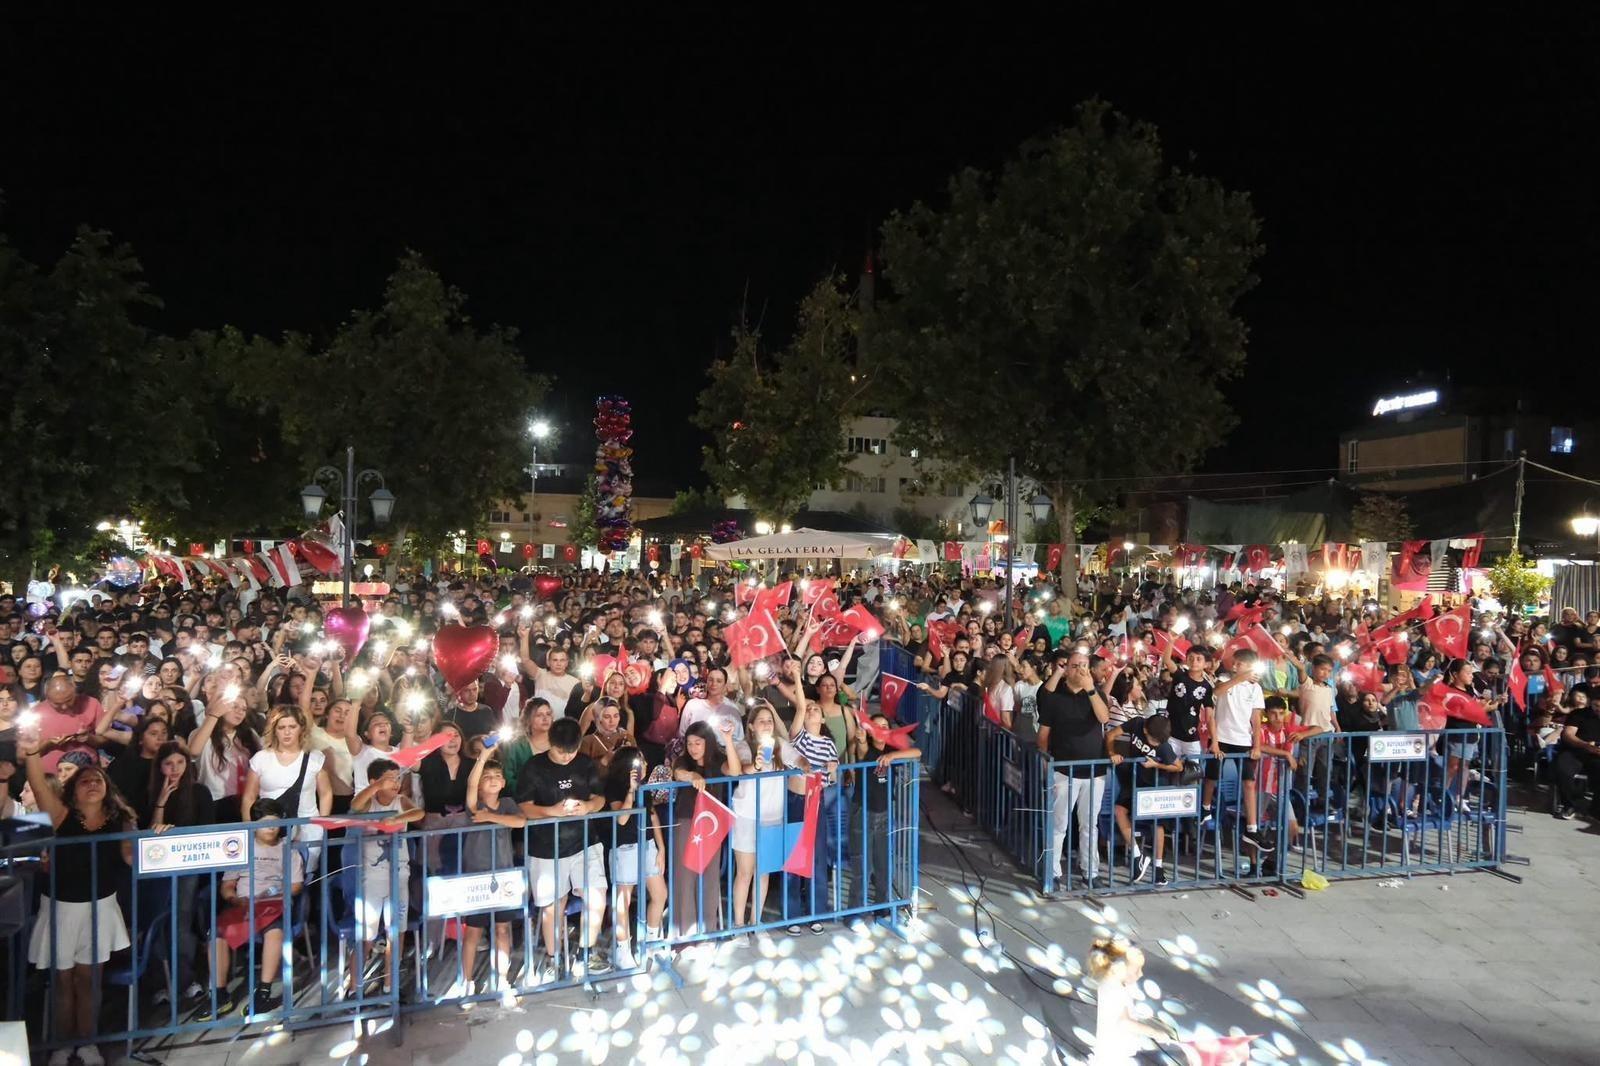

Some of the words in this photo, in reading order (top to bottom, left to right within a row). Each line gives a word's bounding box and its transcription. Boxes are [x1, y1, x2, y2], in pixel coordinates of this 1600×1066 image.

[737, 547, 753, 555] LA
[758, 546, 835, 555] GELATERIA
[182, 853, 210, 862] ZABITA
